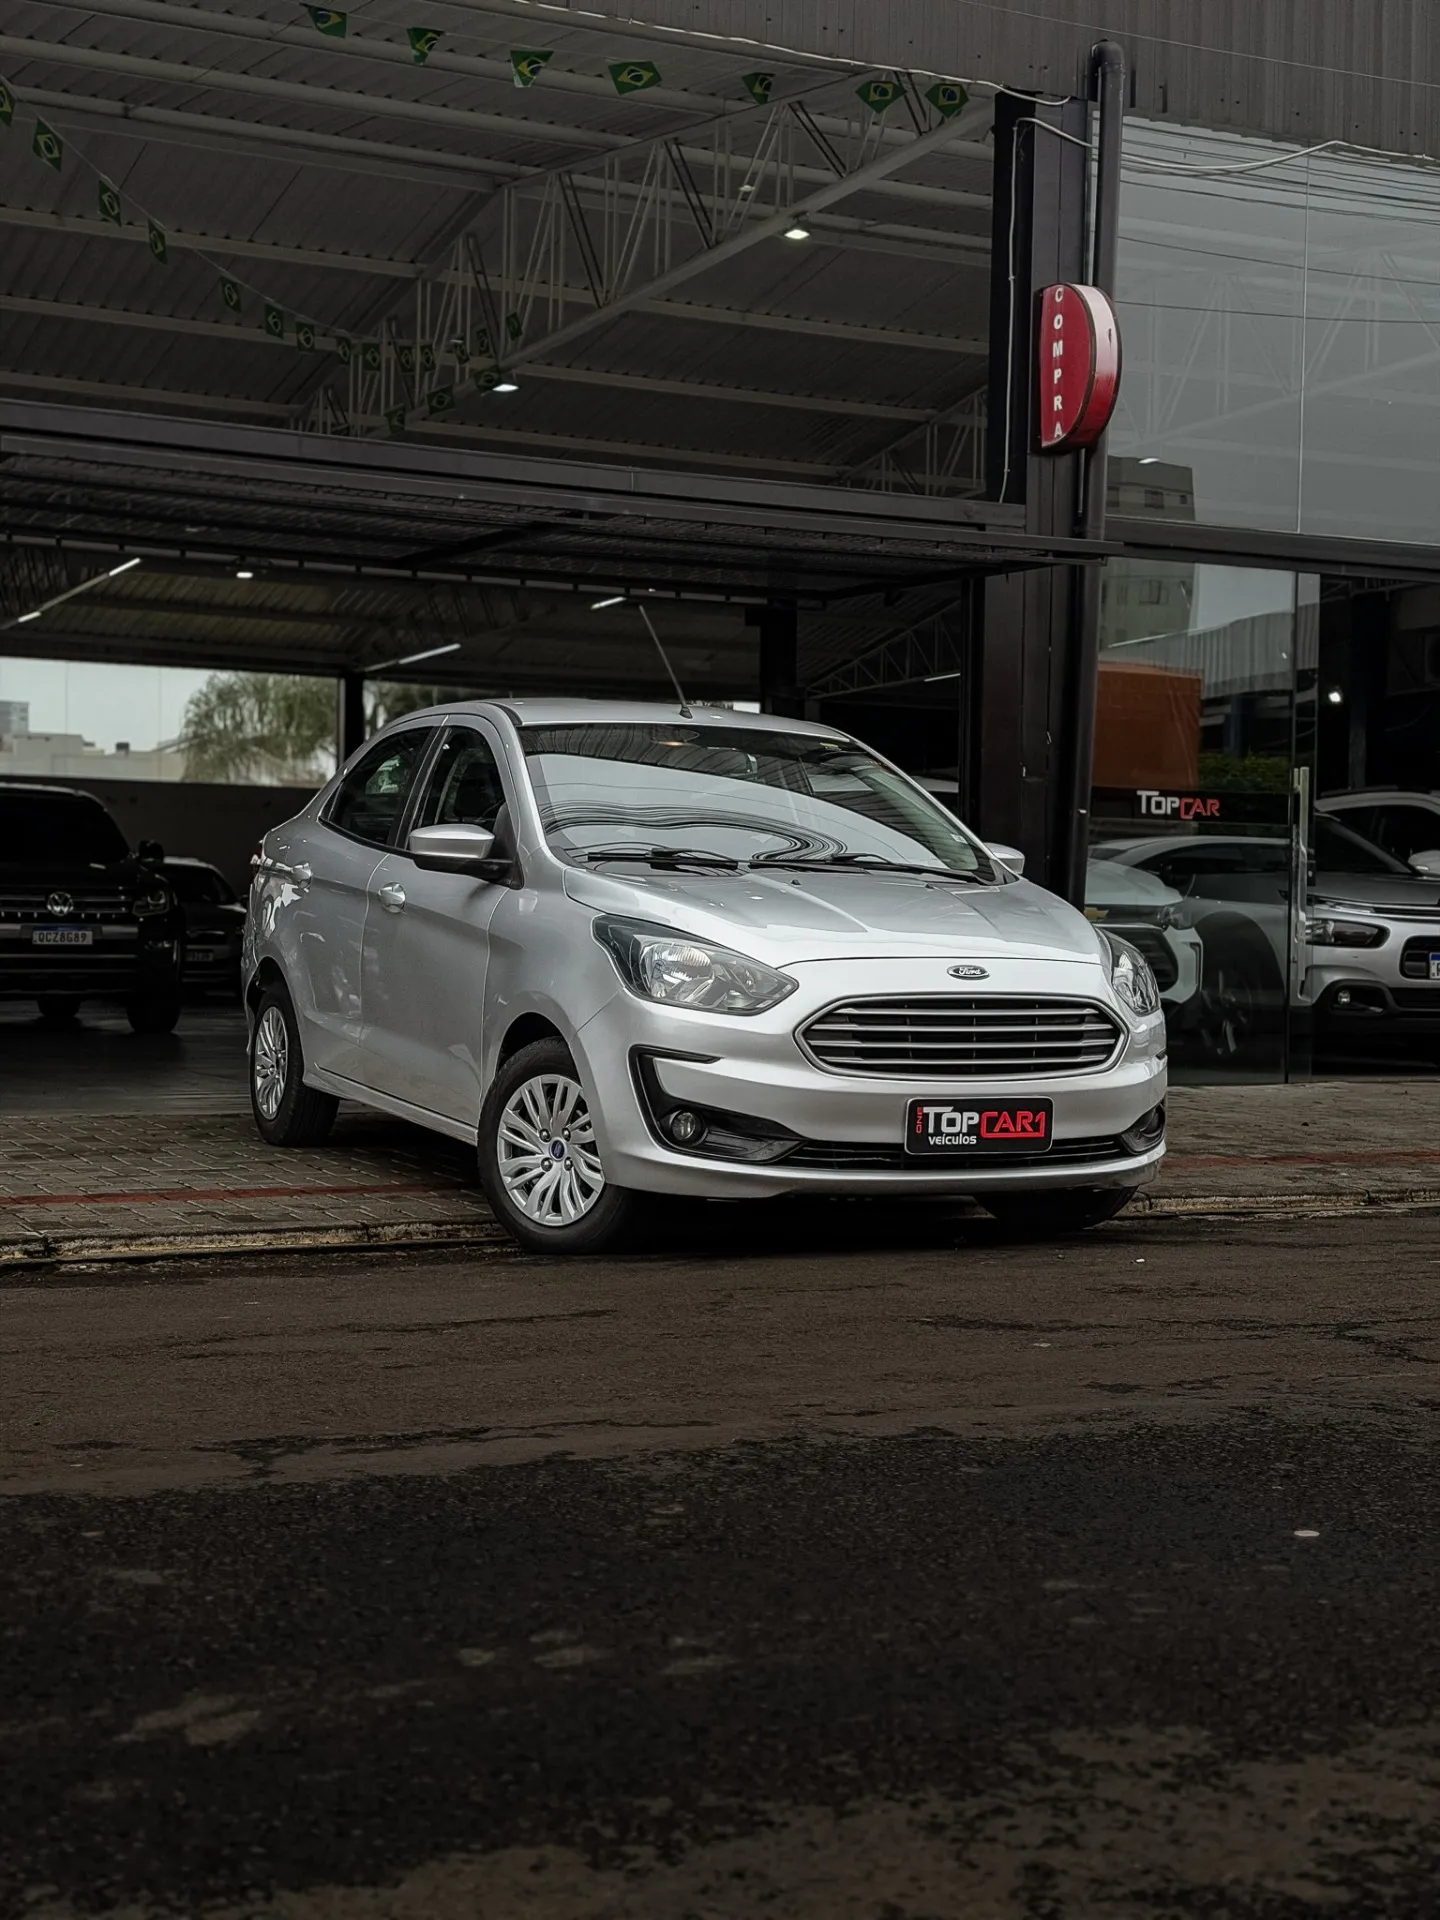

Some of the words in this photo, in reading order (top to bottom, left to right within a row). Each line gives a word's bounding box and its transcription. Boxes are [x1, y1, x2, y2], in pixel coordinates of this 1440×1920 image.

[1052, 287, 1064, 438] COMPRA
[915, 1106, 923, 1134] ONE
[928, 1133, 977, 1145] veículos
